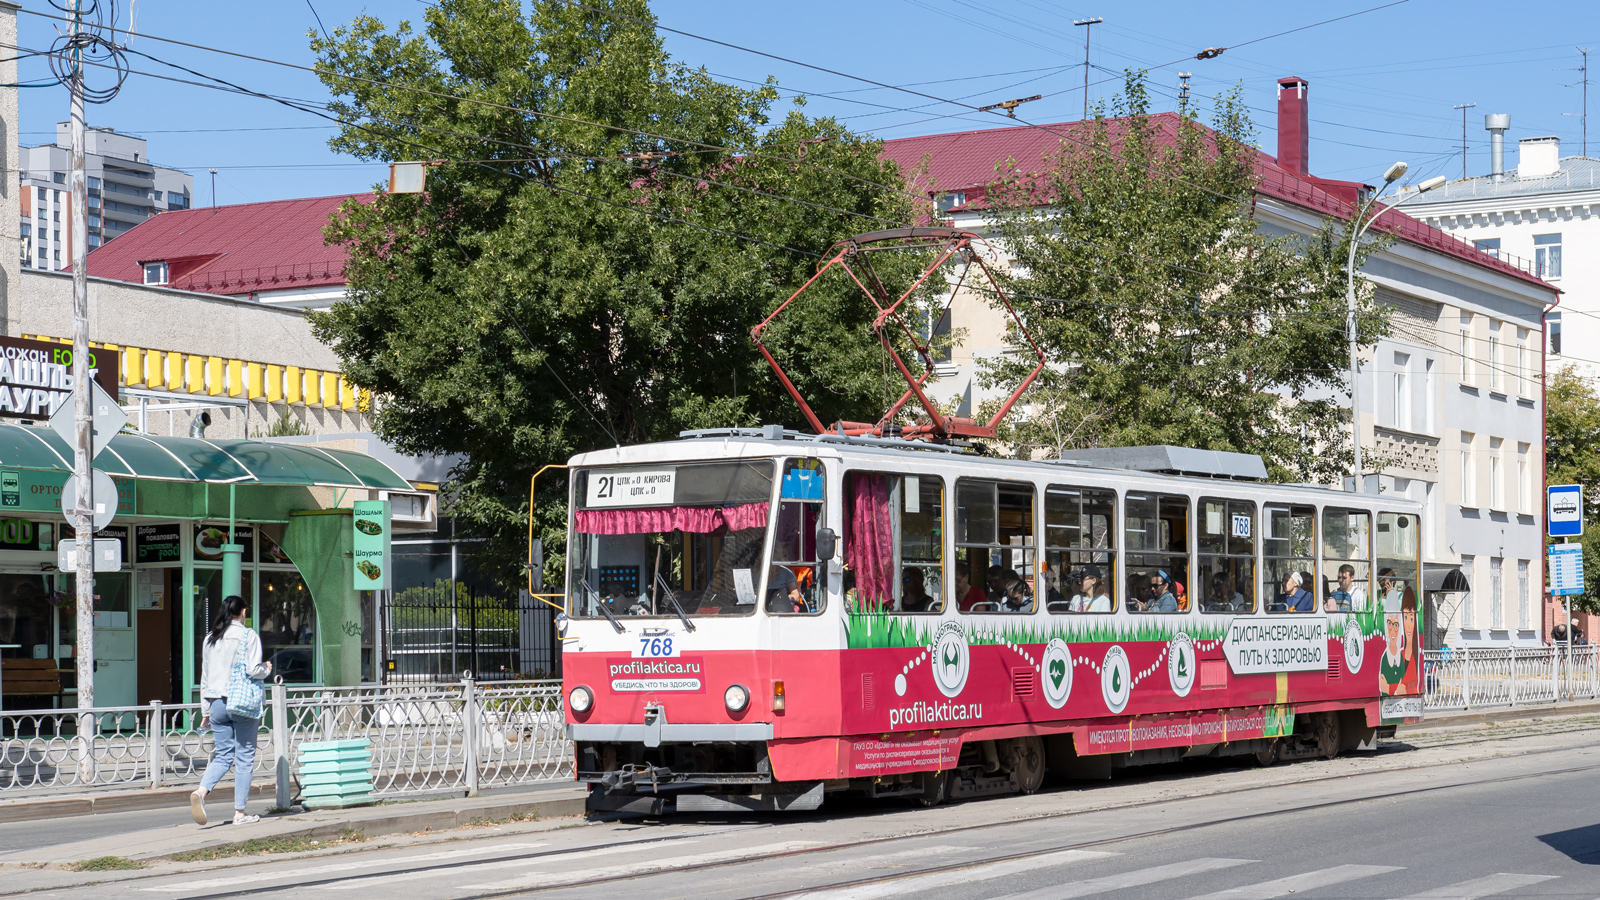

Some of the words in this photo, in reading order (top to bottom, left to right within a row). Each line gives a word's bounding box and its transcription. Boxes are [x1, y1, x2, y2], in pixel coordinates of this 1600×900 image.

[597, 476, 614, 498] 21
[1234, 517, 1249, 535] 768
[1232, 625, 1321, 645] ДИСПАНСЕРИЗАЦИЯ
[640, 638, 673, 656] 768
[1240, 649, 1262, 666] ПУТЬ
[1265, 648, 1271, 664] К
[1272, 647, 1321, 667] ЗДОРОВЬЮ
[609, 661, 701, 677] profilaktica.ru
[889, 700, 982, 730] profilaktica.ru
